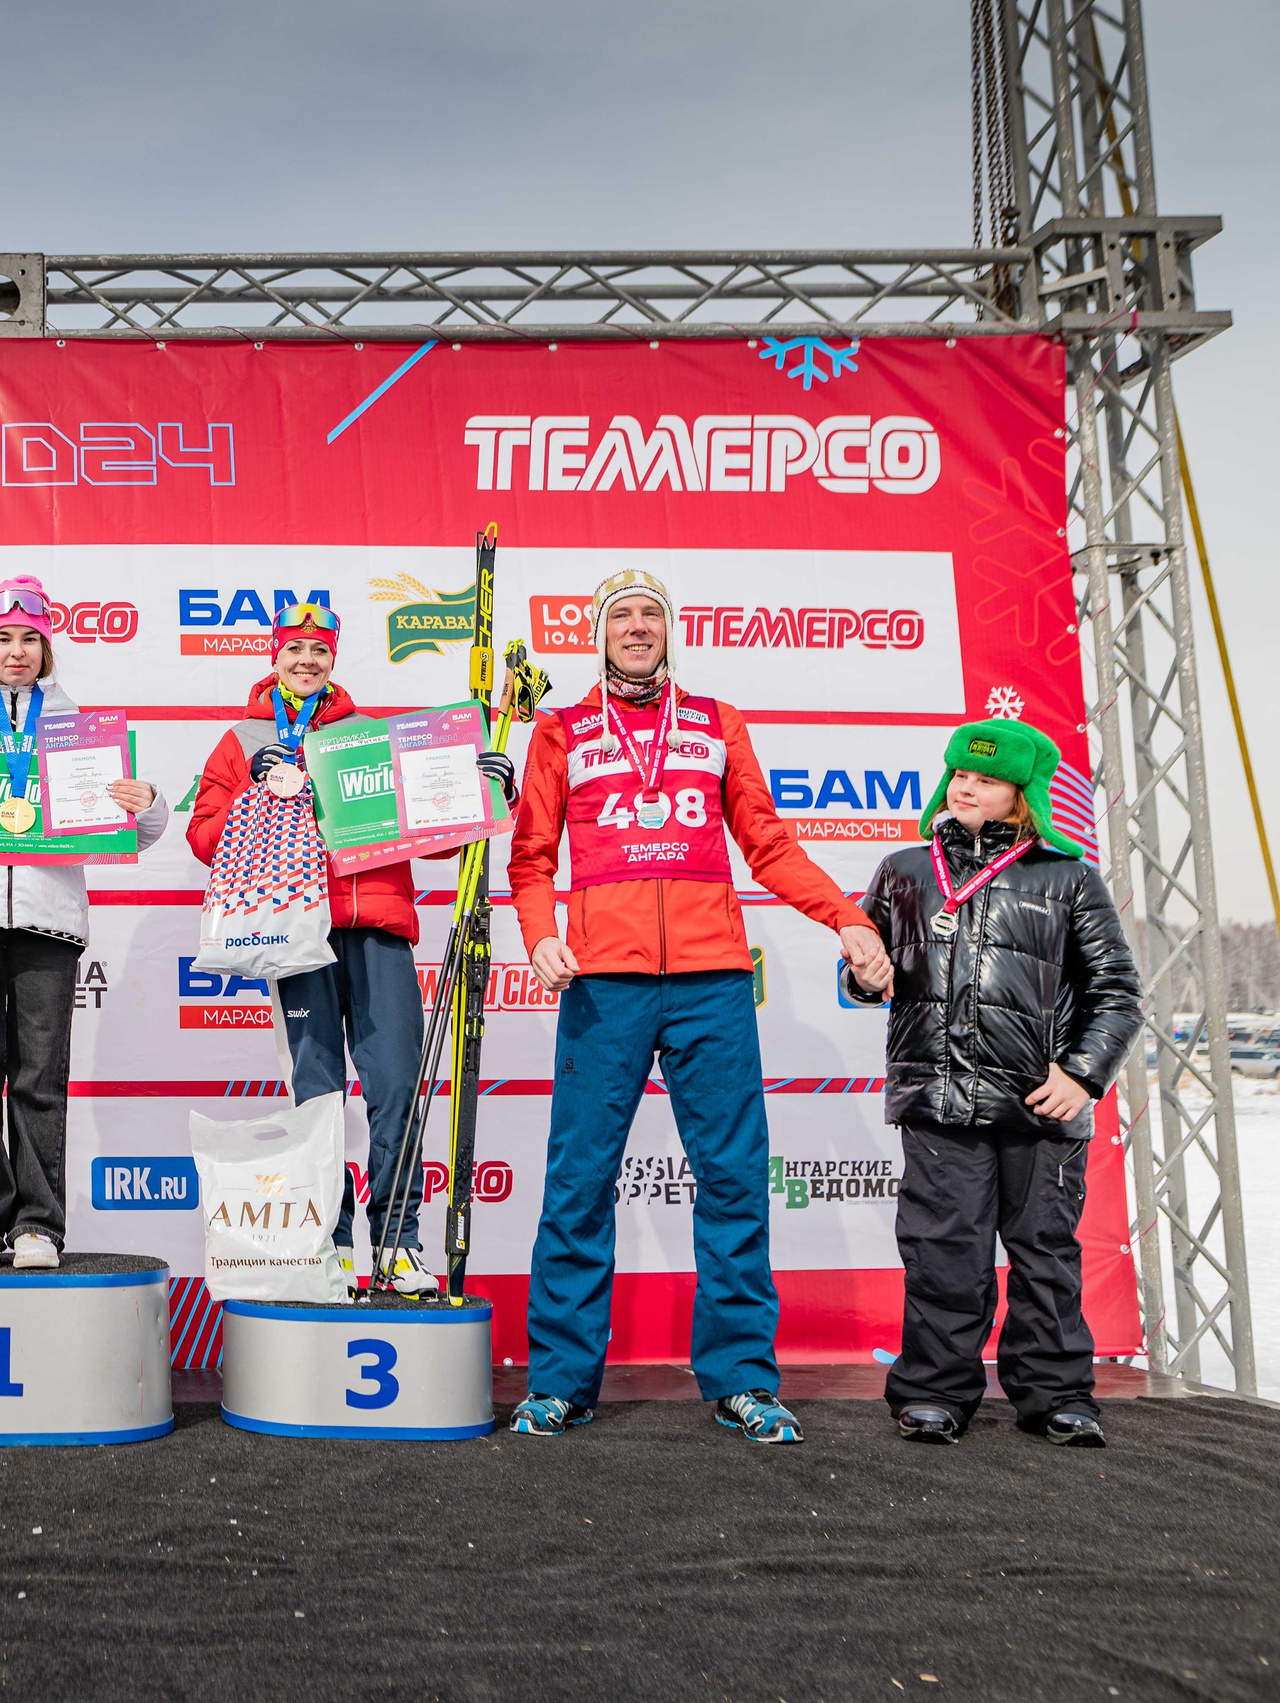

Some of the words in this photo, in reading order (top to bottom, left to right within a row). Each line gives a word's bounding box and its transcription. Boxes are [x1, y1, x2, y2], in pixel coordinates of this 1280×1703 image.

[204, 637, 273, 653] МАРАФ
[44, 734, 79, 743] ТЕМЕРСО
[45, 741, 74, 749] АНГАРА
[397, 733, 433, 743] ТЕМЕРСО
[398, 740, 428, 750] АНГАРА
[72, 755, 97, 763] ГРАМОТА
[770, 769, 922, 810] БАМ
[796, 821, 902, 839] МАРАФОНЫ
[621, 842, 690, 854] ТЕМЕРСО
[627, 852, 686, 863] АНГАРА
[225, 931, 290, 950] росбанк
[204, 1009, 275, 1026] МАРАФ
[104, 1167, 188, 1201] IRK.RU
[209, 1198, 323, 1230] АМТА
[211, 1256, 266, 1269] Традиции
[269, 1254, 322, 1267] качества
[345, 1339, 400, 1410] 3
